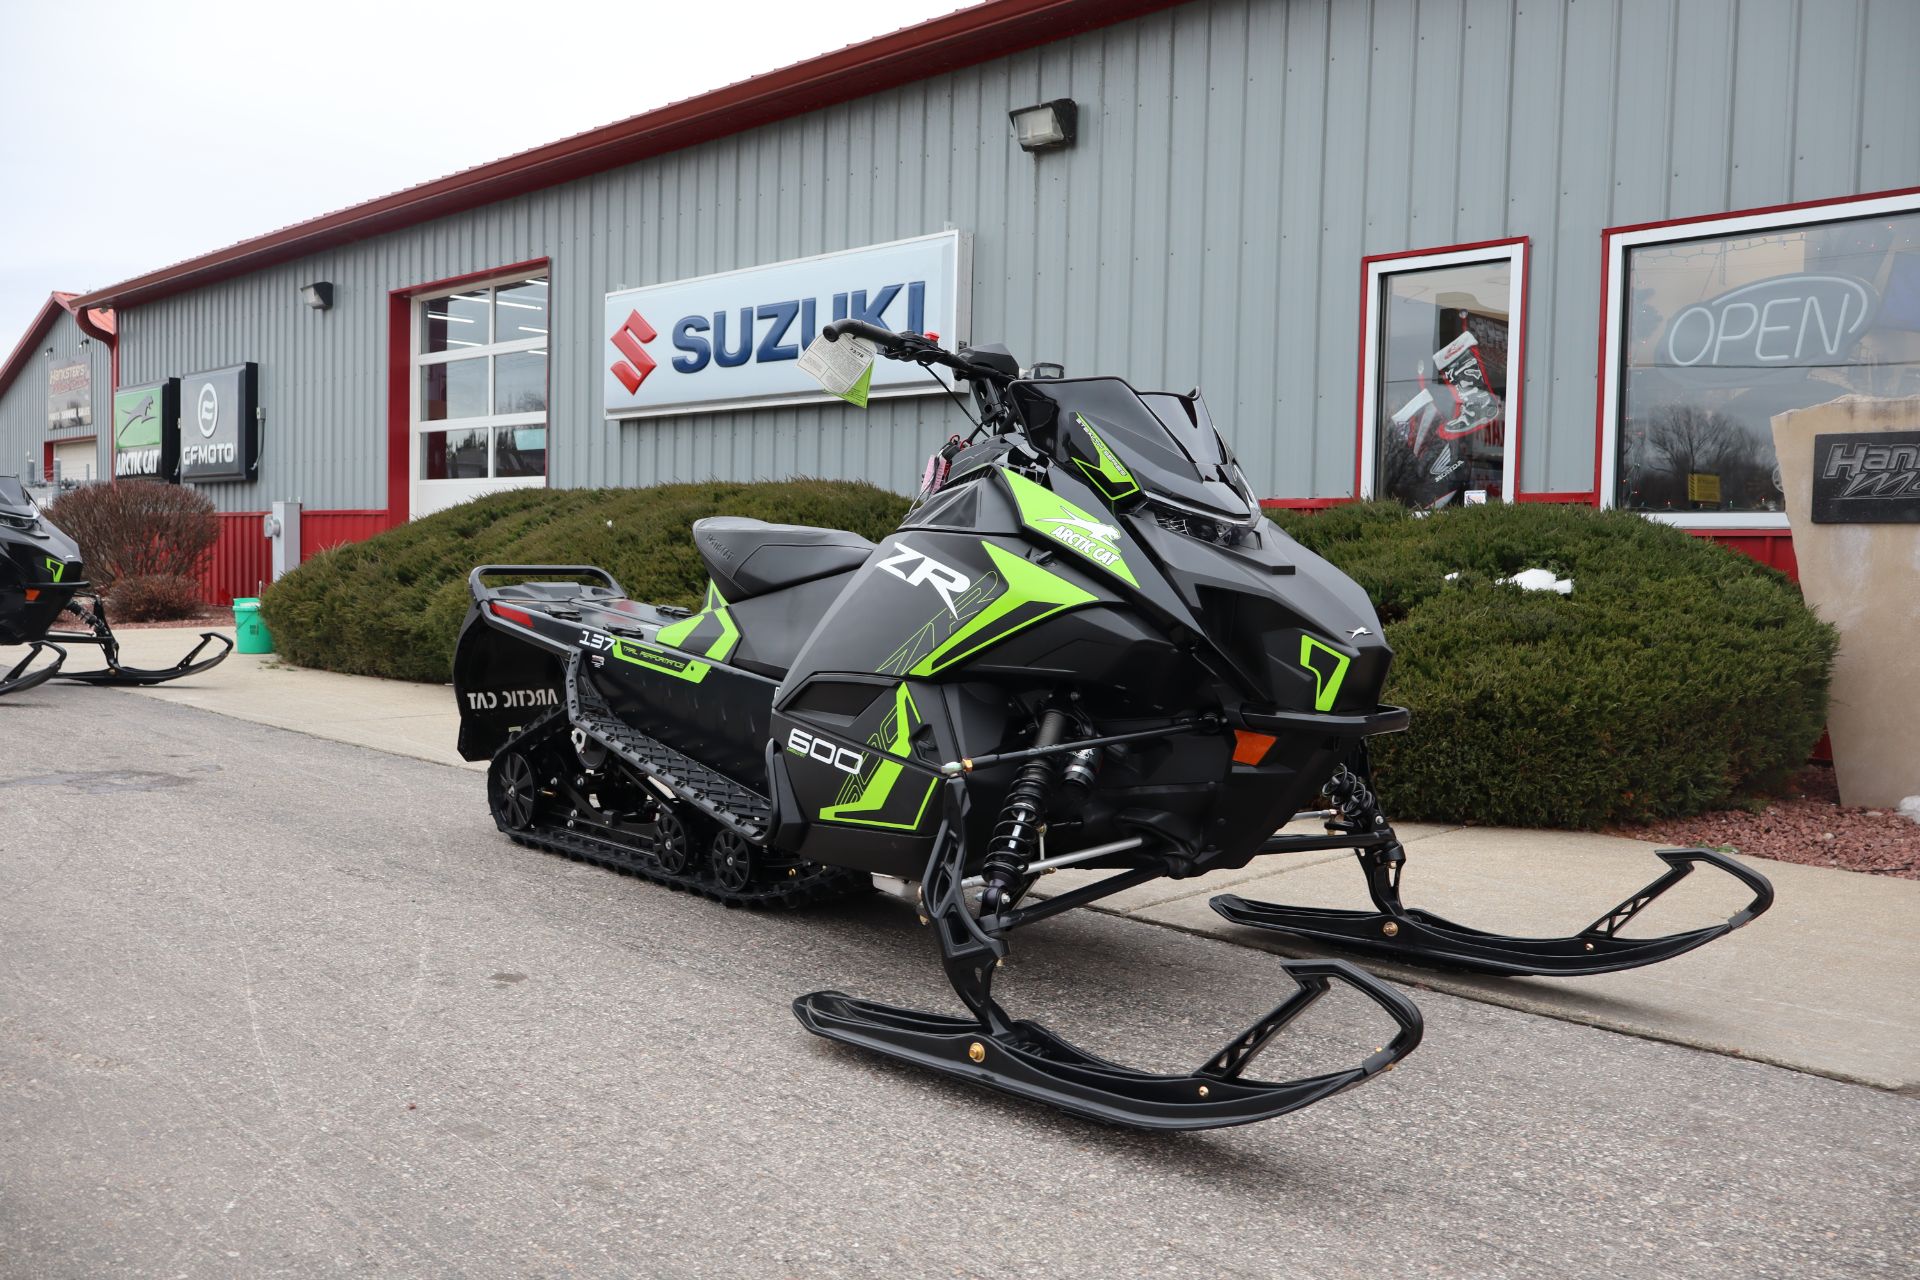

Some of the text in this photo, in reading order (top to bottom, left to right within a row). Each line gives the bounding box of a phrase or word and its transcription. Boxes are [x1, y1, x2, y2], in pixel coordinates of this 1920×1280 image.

[672, 280, 926, 374] SUZUKI
[1668, 293, 1850, 367] OPEN
[115, 450, 160, 476] ARCTIC CAT
[183, 443, 234, 466] CFMOTO
[1435, 460, 1465, 483] HONDA
[1823, 443, 1920, 480] Han
[1051, 525, 1120, 566] ARCTIC CAT
[875, 541, 971, 621] ZR
[579, 630, 616, 651] 137
[788, 728, 864, 775] 600
